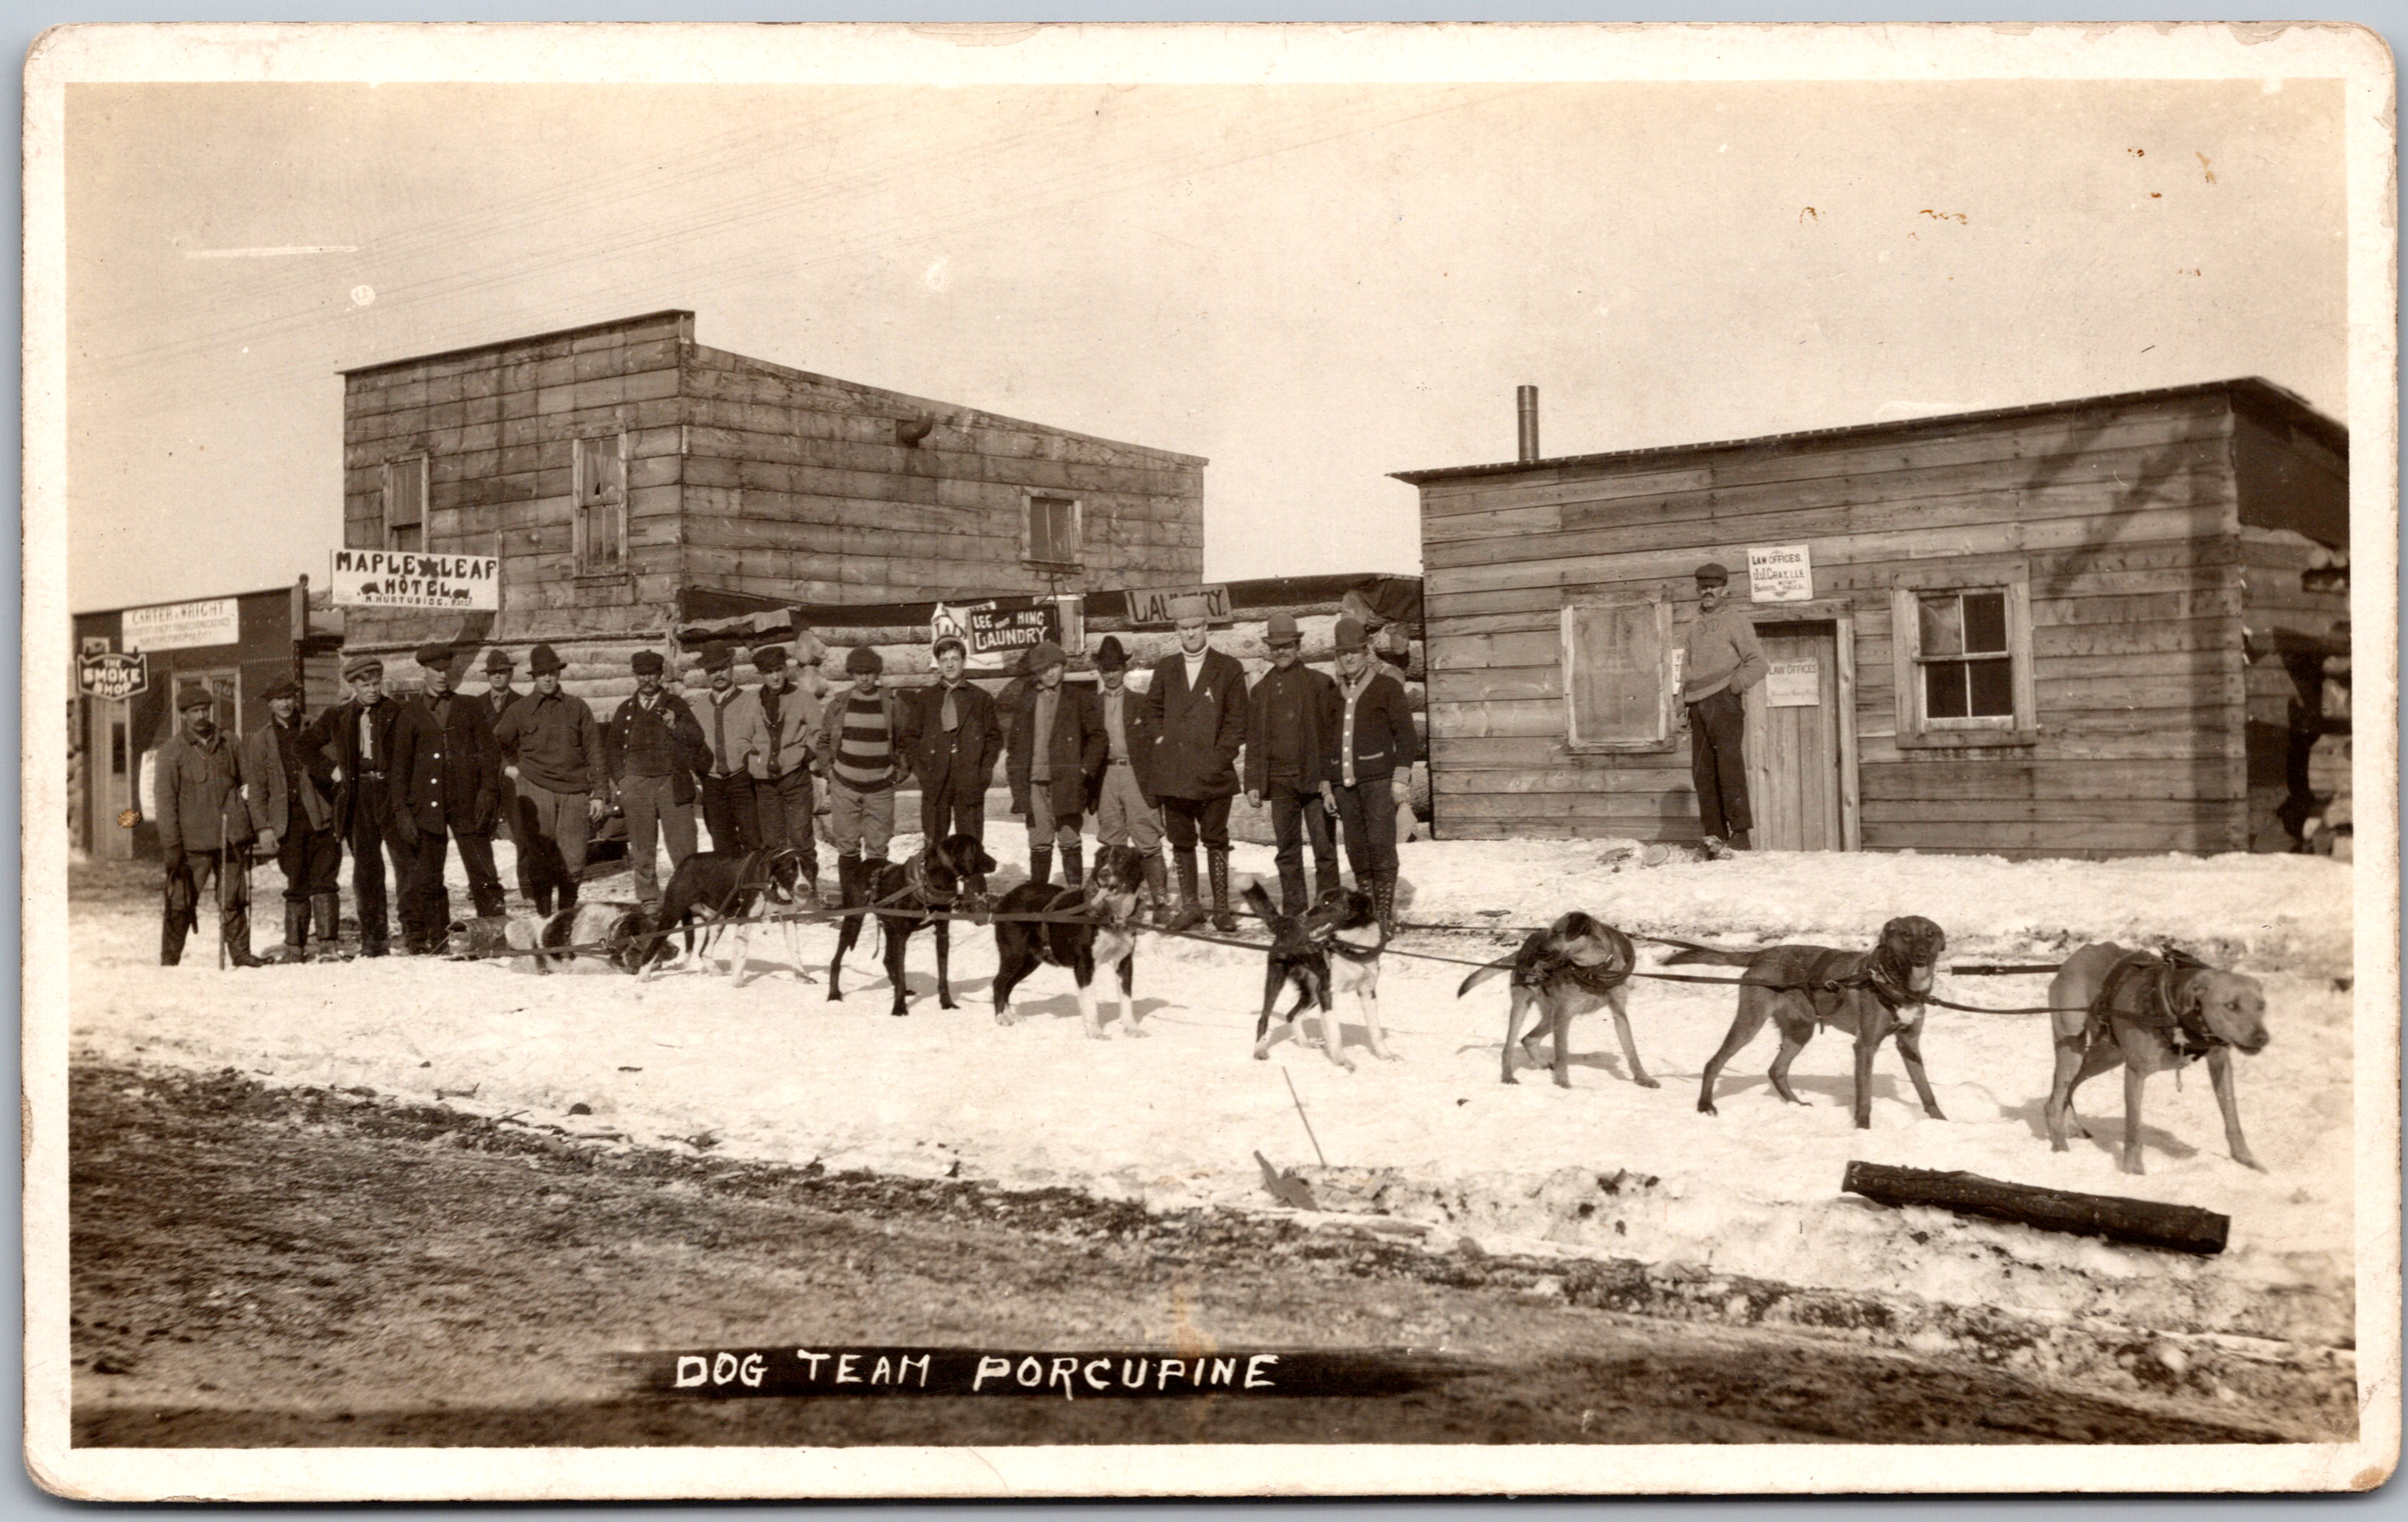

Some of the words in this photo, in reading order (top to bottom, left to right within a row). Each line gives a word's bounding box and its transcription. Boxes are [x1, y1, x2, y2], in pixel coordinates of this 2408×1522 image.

[336, 551, 416, 576] MAPLE
[440, 558, 497, 579] LEAF
[1752, 556, 1767, 565] LAW
[181, 601, 225, 618] WRIGHT
[973, 614, 993, 629] LEE
[1017, 611, 1045, 626] HING
[103, 659, 121, 668] THE
[83, 668, 141, 683] SMOKE
[93, 681, 132, 696] SHOP
